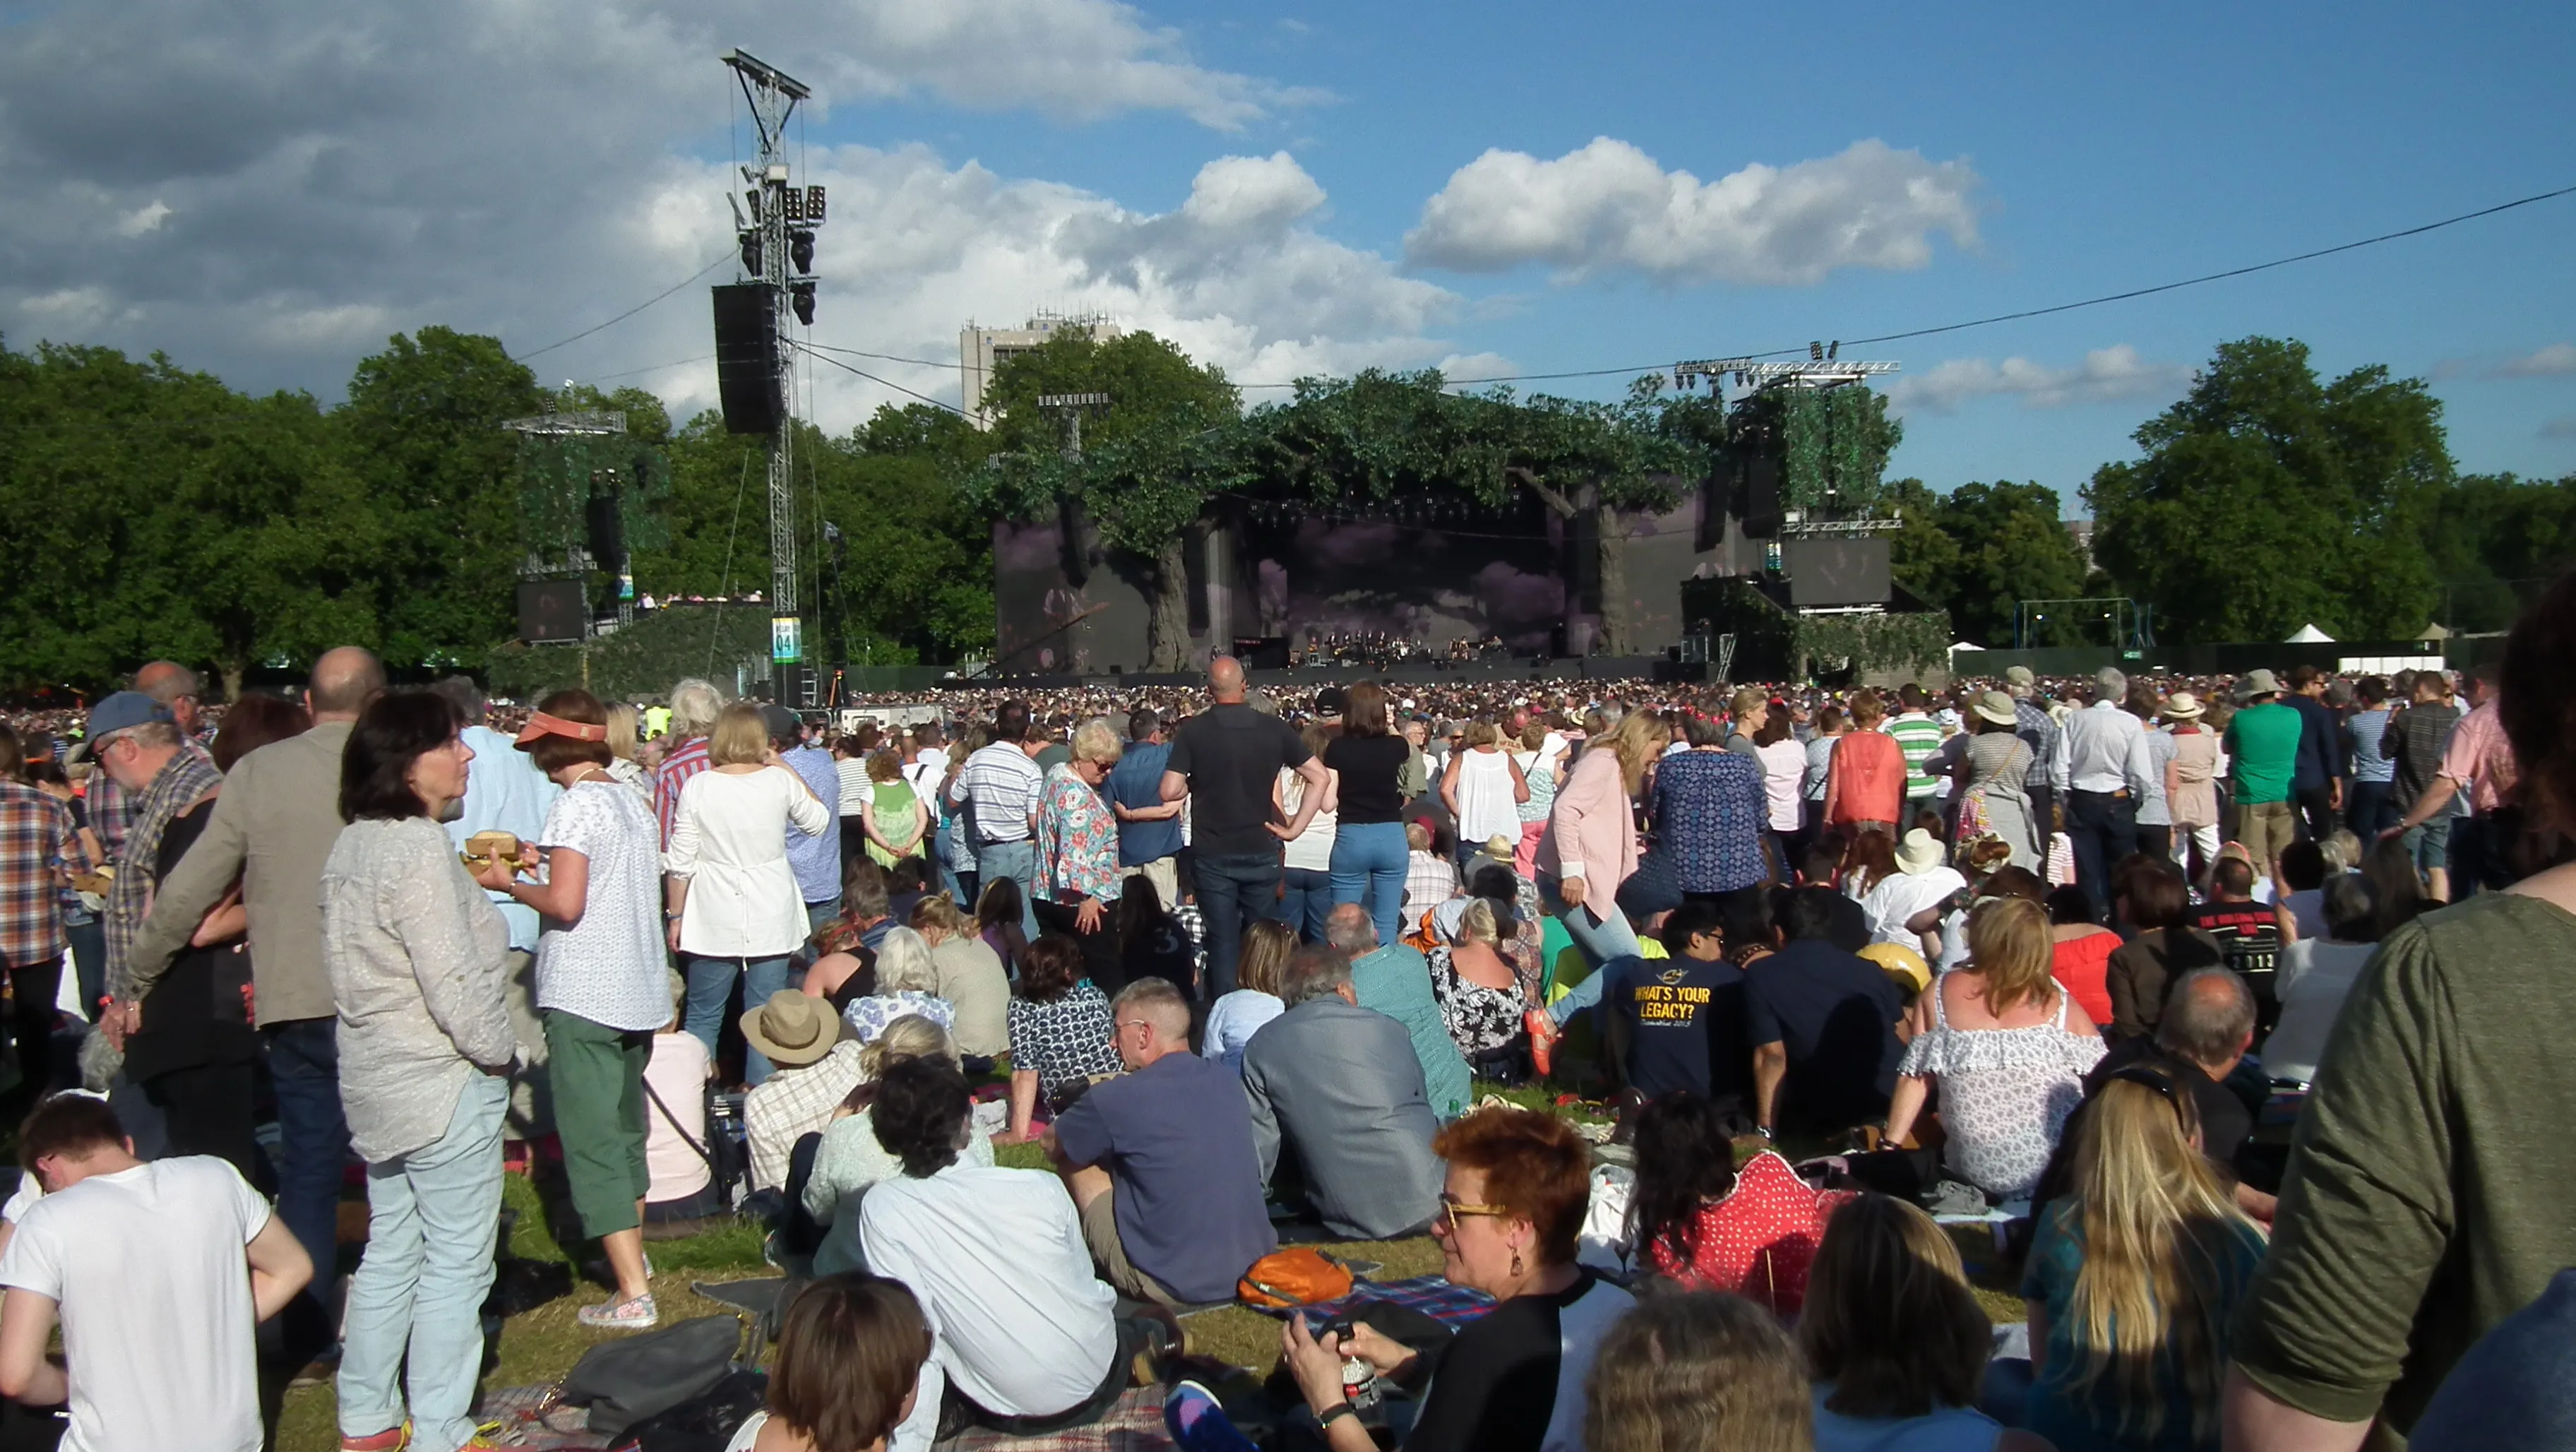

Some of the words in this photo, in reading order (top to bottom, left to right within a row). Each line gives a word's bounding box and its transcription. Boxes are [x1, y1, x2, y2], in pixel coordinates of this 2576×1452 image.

[776, 634, 791, 650] 04
[1634, 984, 1674, 1001] WHAT'S
[1676, 986, 1712, 1004] YOUR
[1640, 1001, 1695, 1019] LEGACY?
